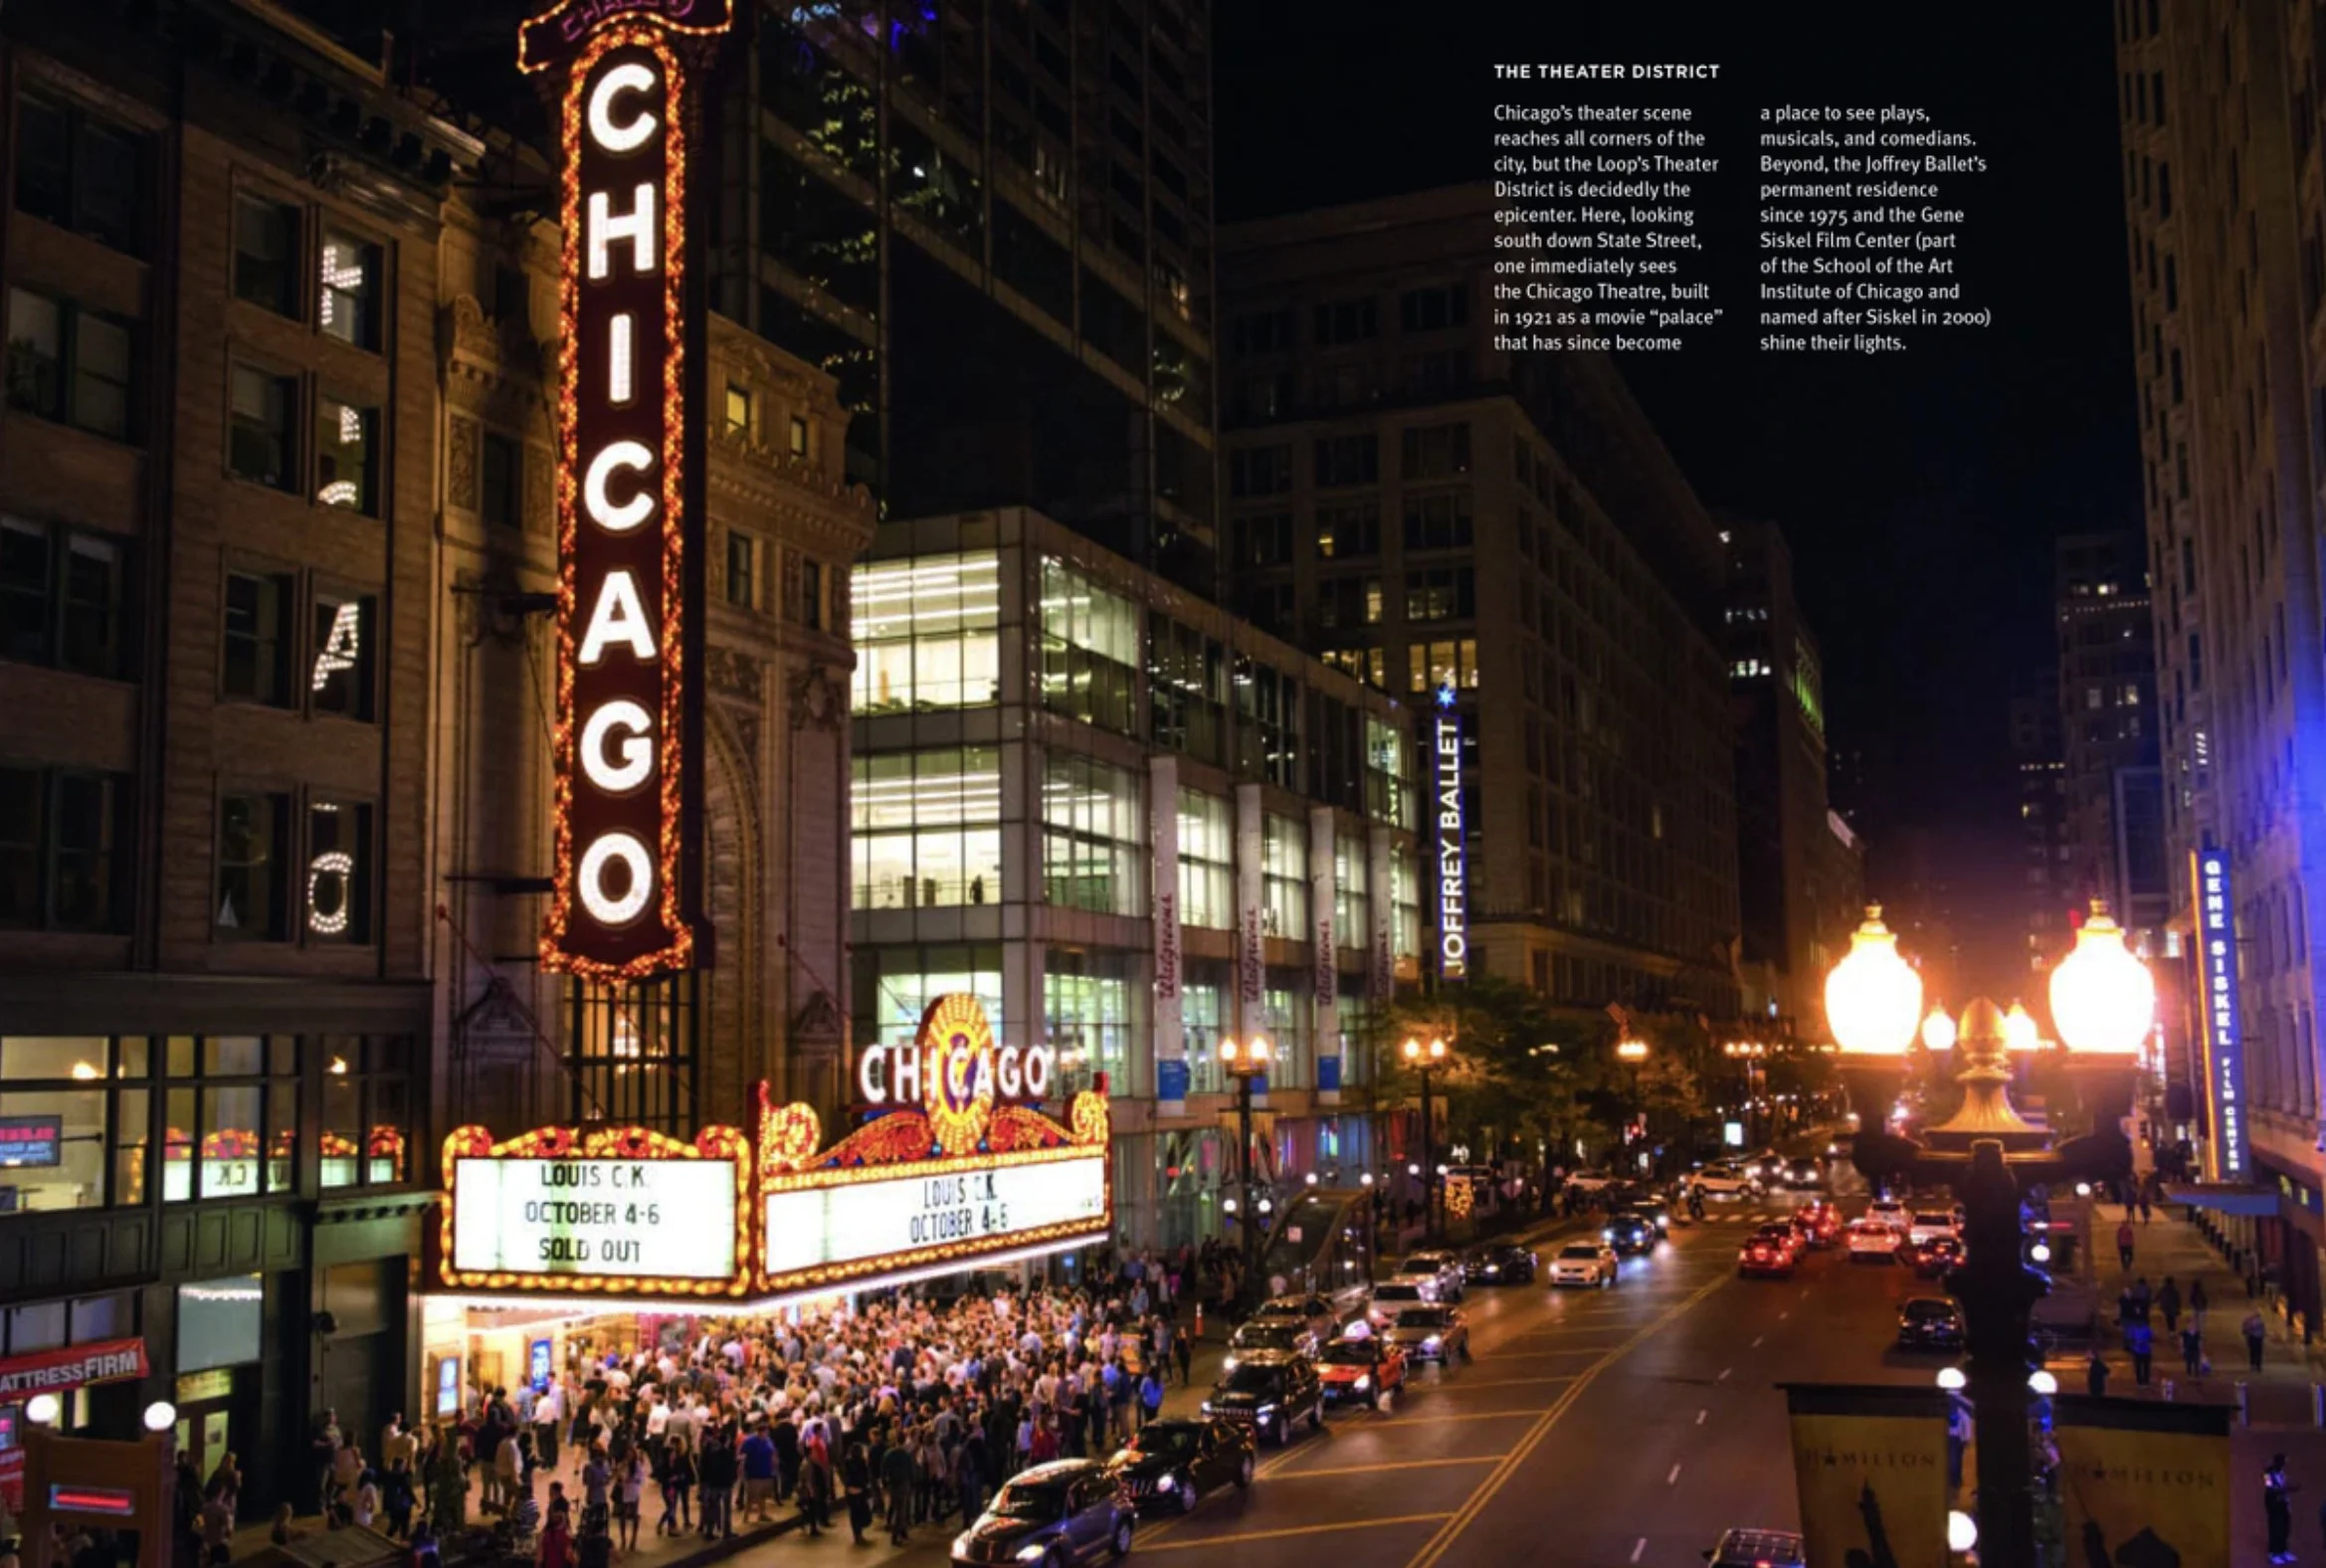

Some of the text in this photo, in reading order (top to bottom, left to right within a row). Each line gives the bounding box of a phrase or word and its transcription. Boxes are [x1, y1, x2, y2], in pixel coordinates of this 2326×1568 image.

[579, 62, 657, 927] CHICAGO
[1438, 719, 1465, 974] JOFFREY BALLET
[2205, 860, 2224, 928] GENE
[2210, 940, 2230, 1046] SISKEL
[861, 1045, 1048, 1103] CHICAGO
[541, 1164, 601, 1188] LOUIS
[923, 1176, 967, 1210] LOUIS
[525, 1201, 661, 1226] OCTOBER 4-6
[909, 1211, 974, 1245] OCTOBER
[538, 1238, 641, 1264] SOLD OUT
